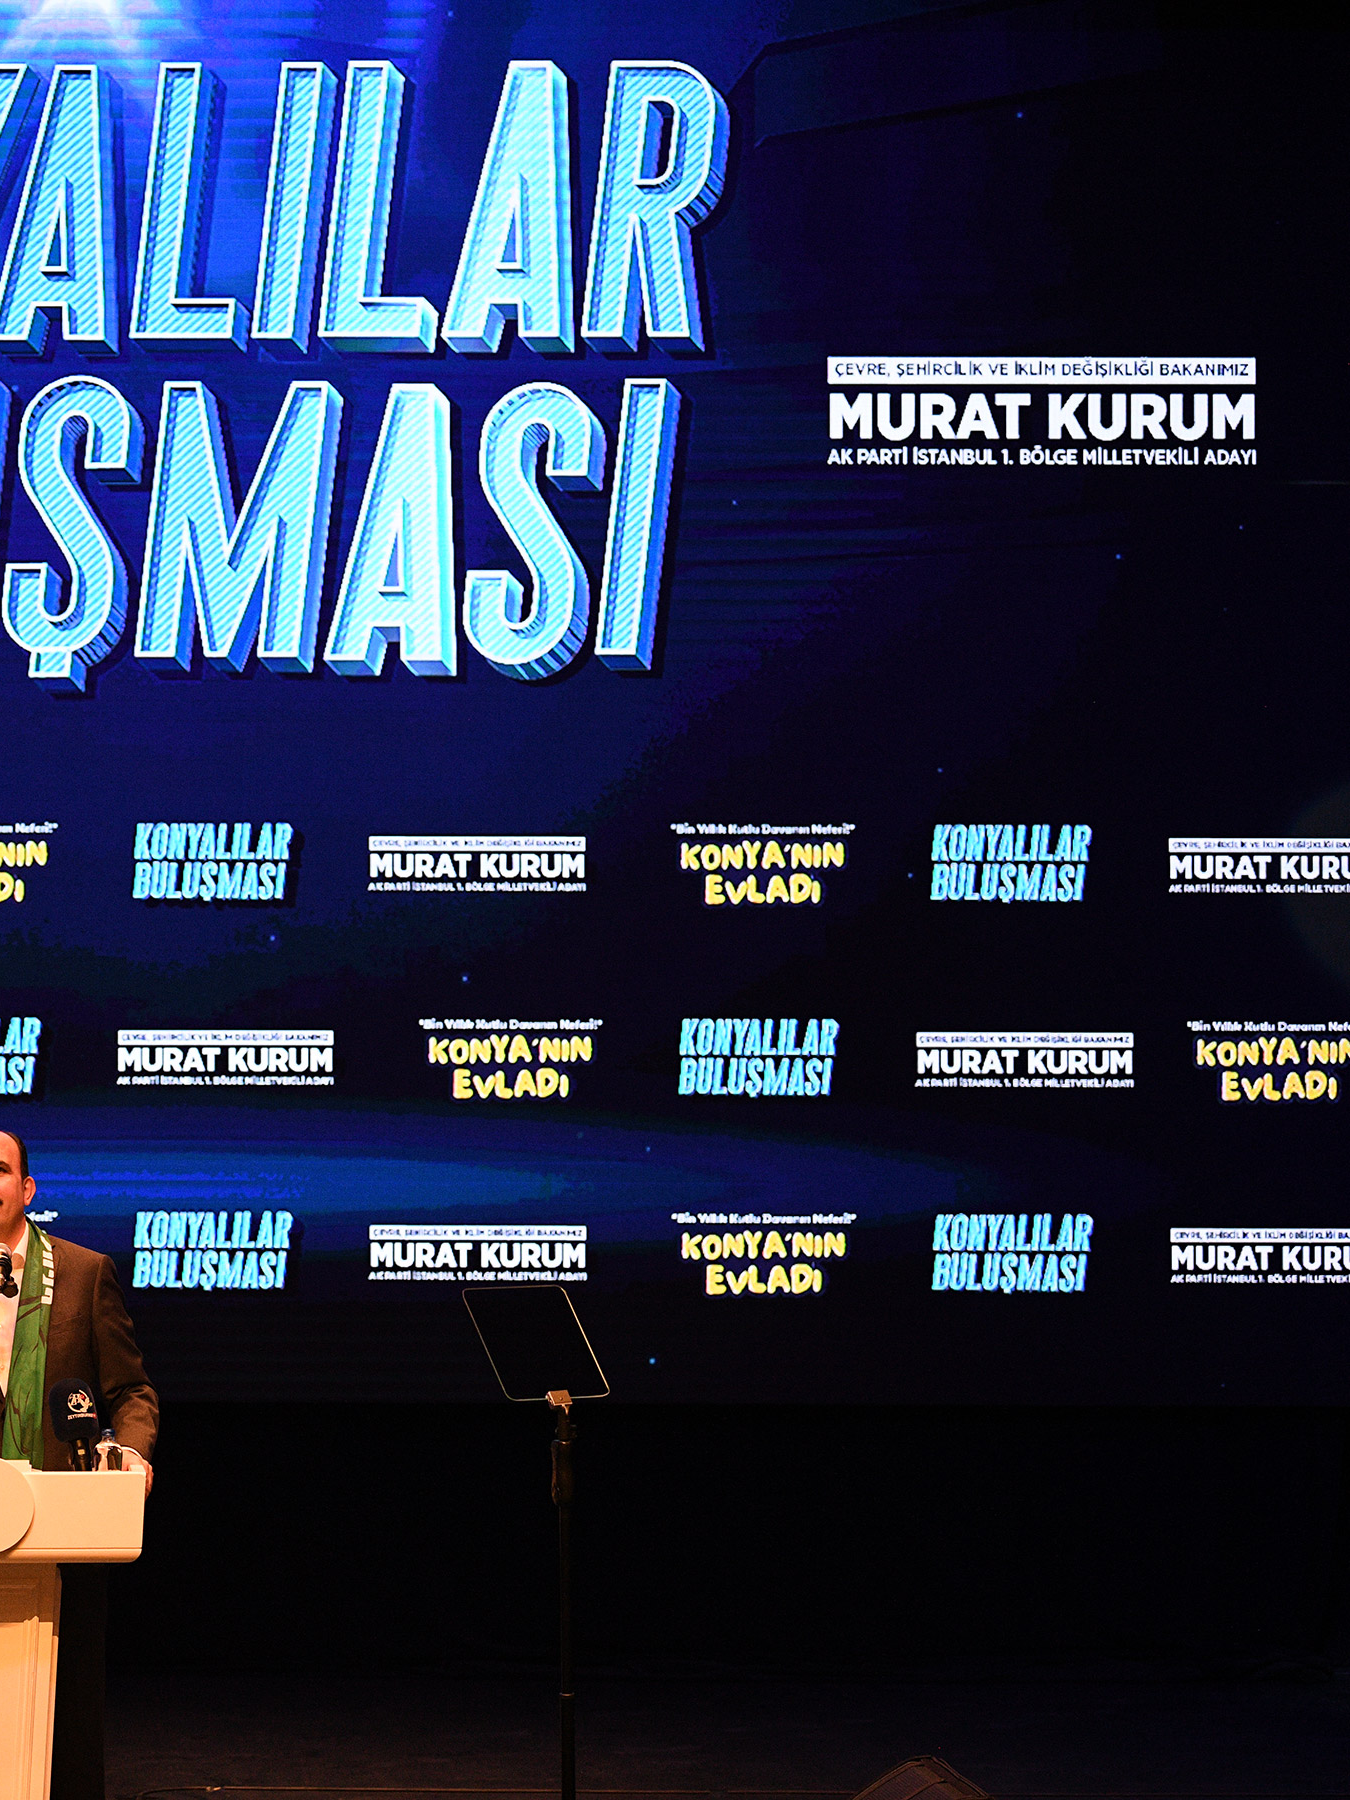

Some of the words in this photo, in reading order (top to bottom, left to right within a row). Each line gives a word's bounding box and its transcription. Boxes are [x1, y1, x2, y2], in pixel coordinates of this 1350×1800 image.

[835, 362, 891, 378] ÇEVRE,
[897, 361, 983, 378] ŞEHİRCİLİK
[988, 363, 1008, 376] VE
[1015, 360, 1056, 376] İKLİM
[1062, 357, 1153, 379] DEĞİŞİKLİĞİ
[1160, 363, 1249, 376] BAKANIMIZ
[830, 393, 1031, 441] MURAT
[1048, 394, 1255, 441] KURUM
[827, 449, 853, 464] AK
[857, 446, 907, 465] PARTİ
[913, 446, 997, 465] İSTANBUL
[1001, 449, 1013, 465] 1.
[1020, 445, 1078, 465] BÖLGE
[1083, 447, 1198, 465] MİLLETVEKİLİ
[1204, 449, 1256, 465] ADAYI
[134, 822, 293, 862] KONYALILAR
[931, 824, 1092, 864] KONYALILAR
[133, 861, 286, 901] BULUŞMASI
[370, 853, 472, 878] MURAT
[480, 854, 584, 878] KURUM
[930, 862, 1085, 903] BULUŞMASI
[1170, 855, 1271, 879] MURAT
[679, 1018, 839, 1056] KONYALILAR
[118, 1047, 220, 1072] MURAT
[228, 1045, 332, 1072] KURUM
[678, 1057, 832, 1098] BULUŞMASI
[918, 1050, 1019, 1074] MURAT
[1028, 1047, 1132, 1074] KURUM
[134, 1210, 293, 1251] KONYALILAR
[933, 1213, 1093, 1254] KONYALILAR
[133, 1249, 287, 1291] BULUŞMASI
[370, 1242, 472, 1268] MURAT
[481, 1240, 585, 1268] KURUM
[931, 1252, 1087, 1294] BULUŞMASI
[1172, 1245, 1273, 1270] MURAT
